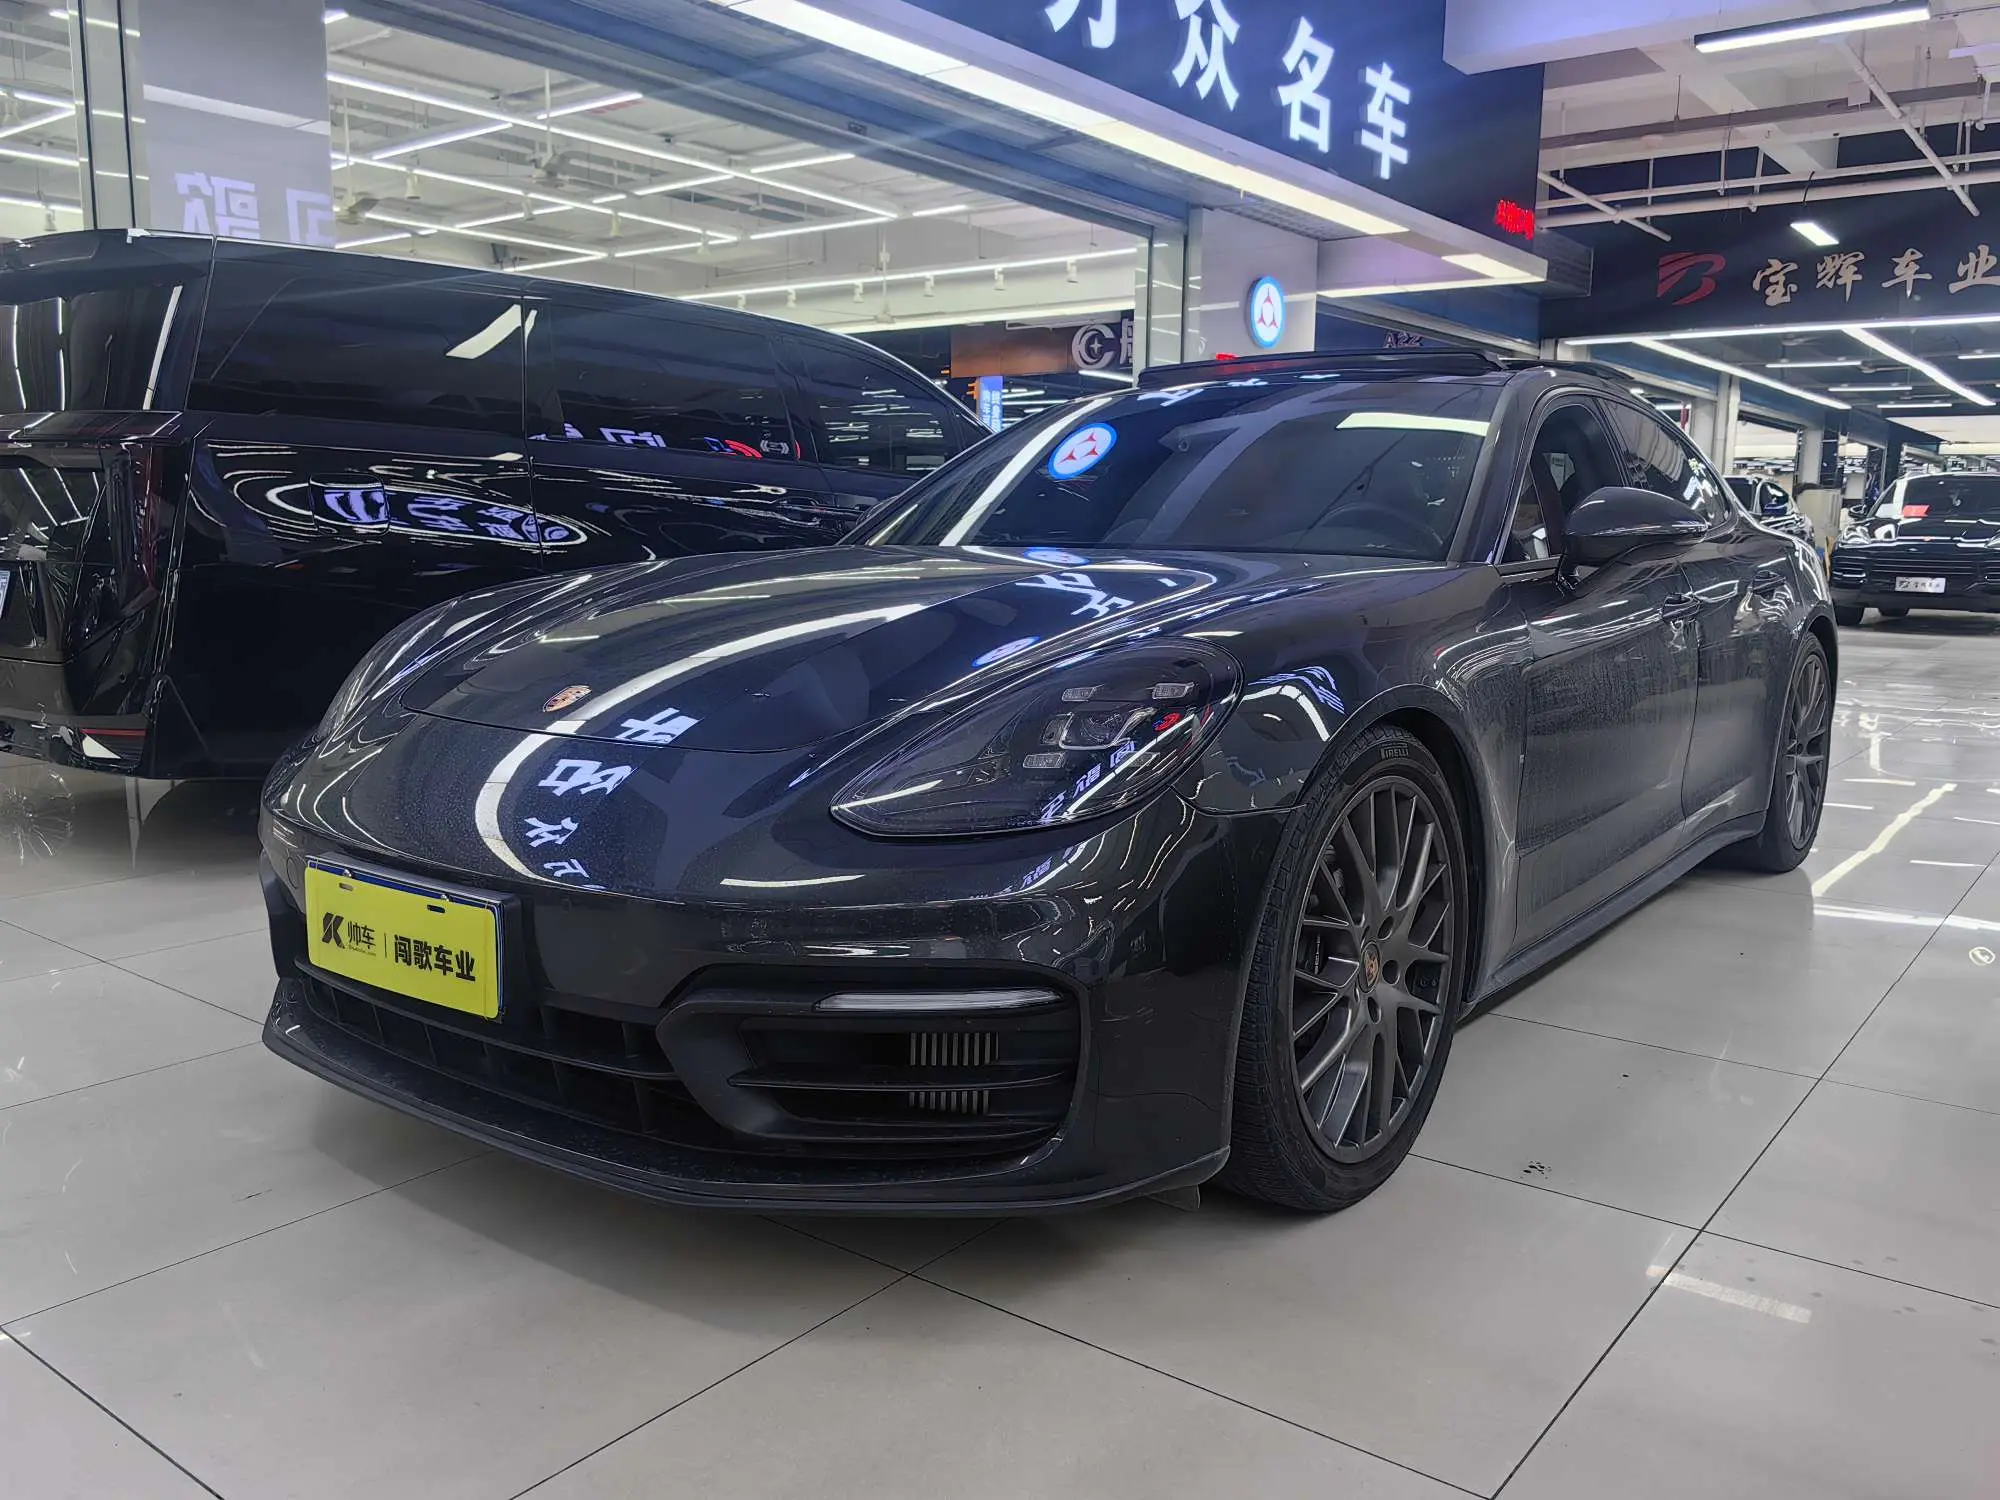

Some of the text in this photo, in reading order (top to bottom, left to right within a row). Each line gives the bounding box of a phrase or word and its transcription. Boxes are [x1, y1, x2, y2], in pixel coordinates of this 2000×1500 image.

[1752, 244, 2000, 306] 宝辉车业
[347, 921, 376, 949] 帅车
[393, 934, 476, 982] 闯歌车业
